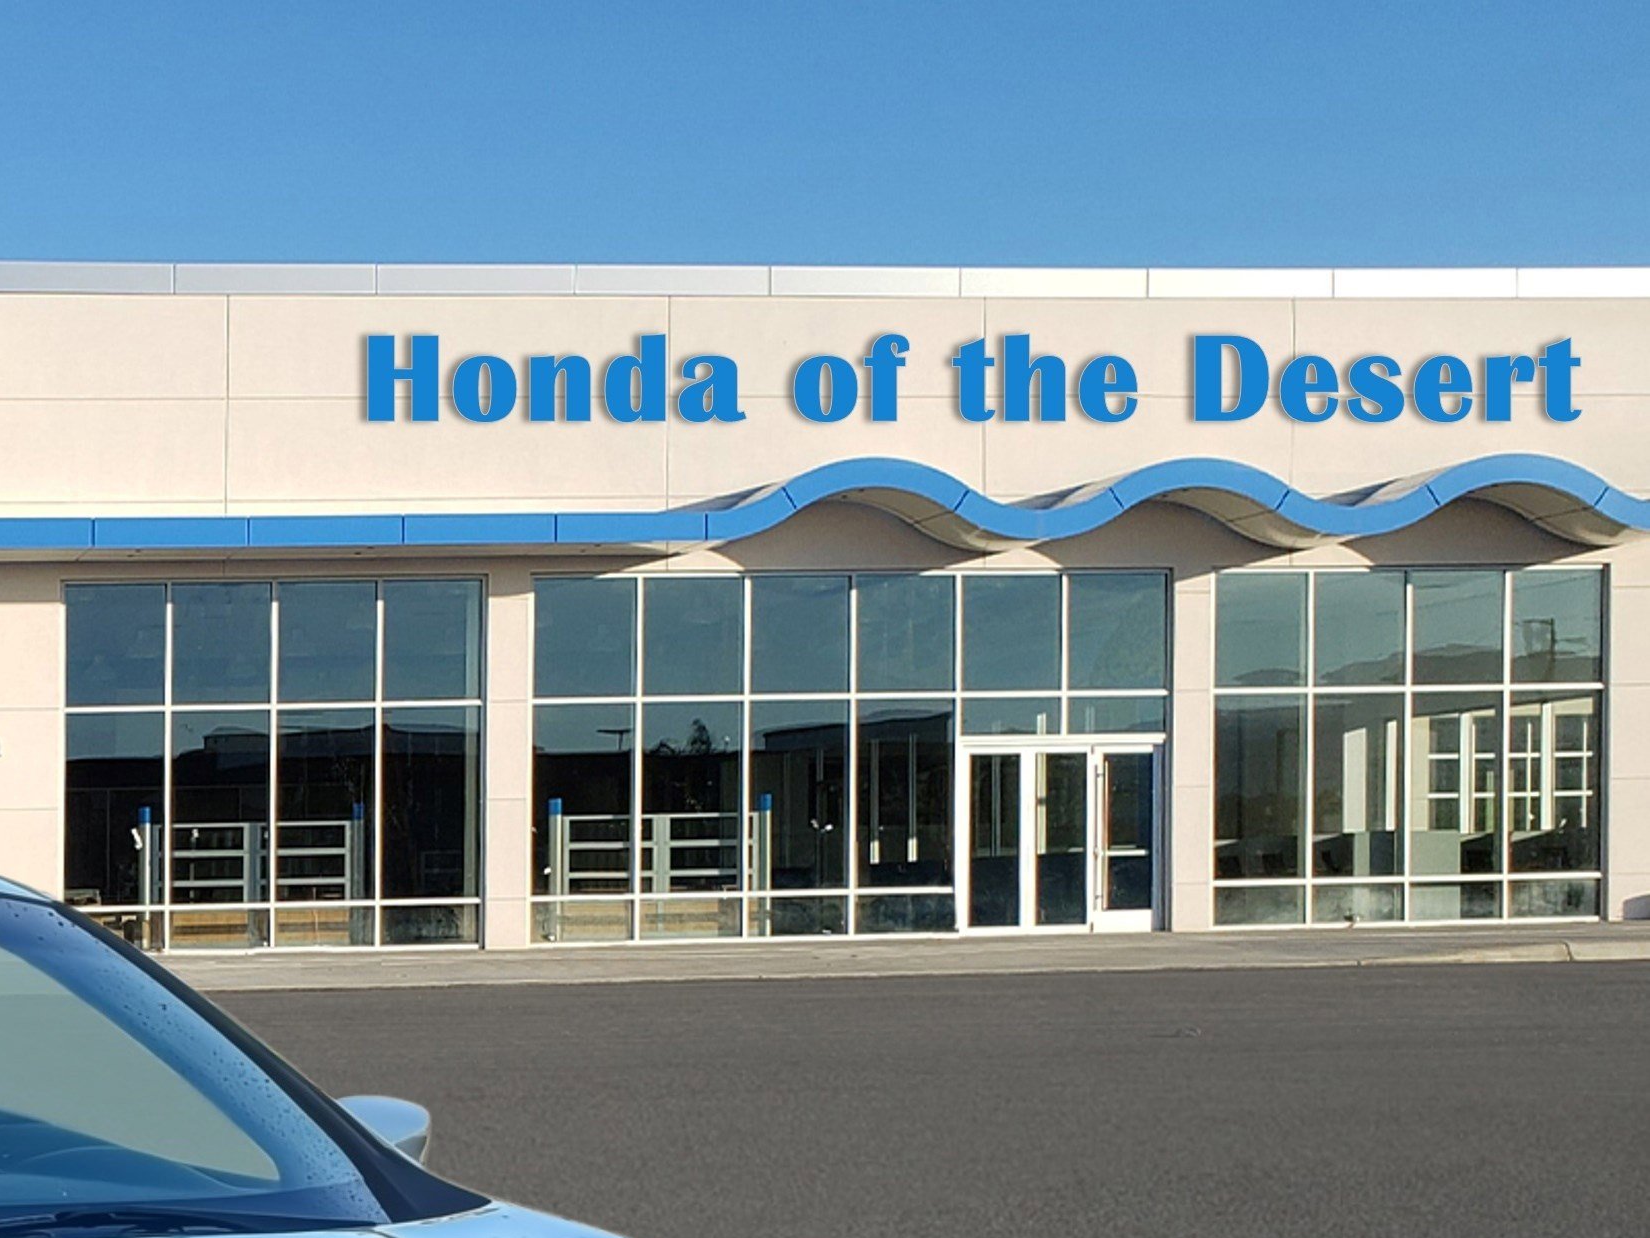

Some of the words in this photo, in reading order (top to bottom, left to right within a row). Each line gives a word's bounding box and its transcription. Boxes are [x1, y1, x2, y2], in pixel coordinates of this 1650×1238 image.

[365, 334, 746, 423] Honda
[793, 334, 910, 423] of
[951, 334, 1139, 423] the
[1193, 334, 1582, 423] Desert
